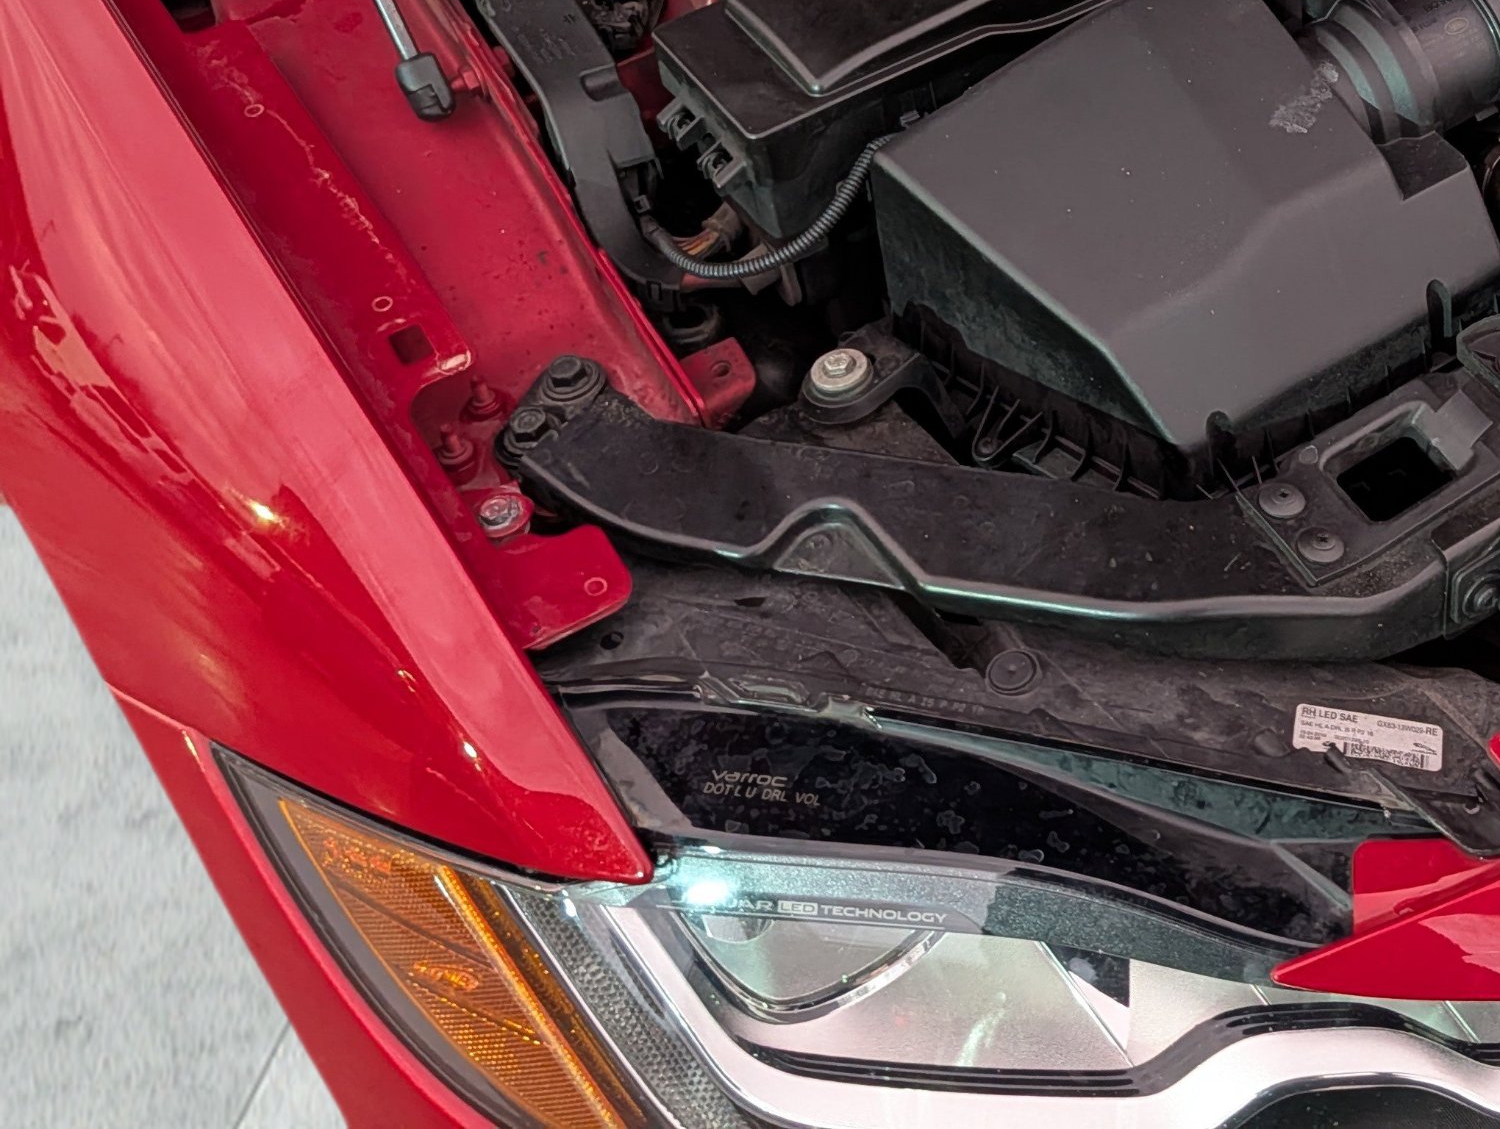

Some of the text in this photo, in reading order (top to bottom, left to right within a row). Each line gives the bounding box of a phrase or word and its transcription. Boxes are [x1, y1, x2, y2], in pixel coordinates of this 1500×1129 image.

[1302, 706, 1316, 717] RH
[1318, 708, 1337, 719] LED
[1339, 711, 1358, 723] SAE
[745, 786, 757, 798] U
[761, 788, 787, 802] DRL
[795, 791, 820, 806] VOL
[780, 901, 817, 914] LED
[821, 904, 948, 923] TECHNOLOGY
